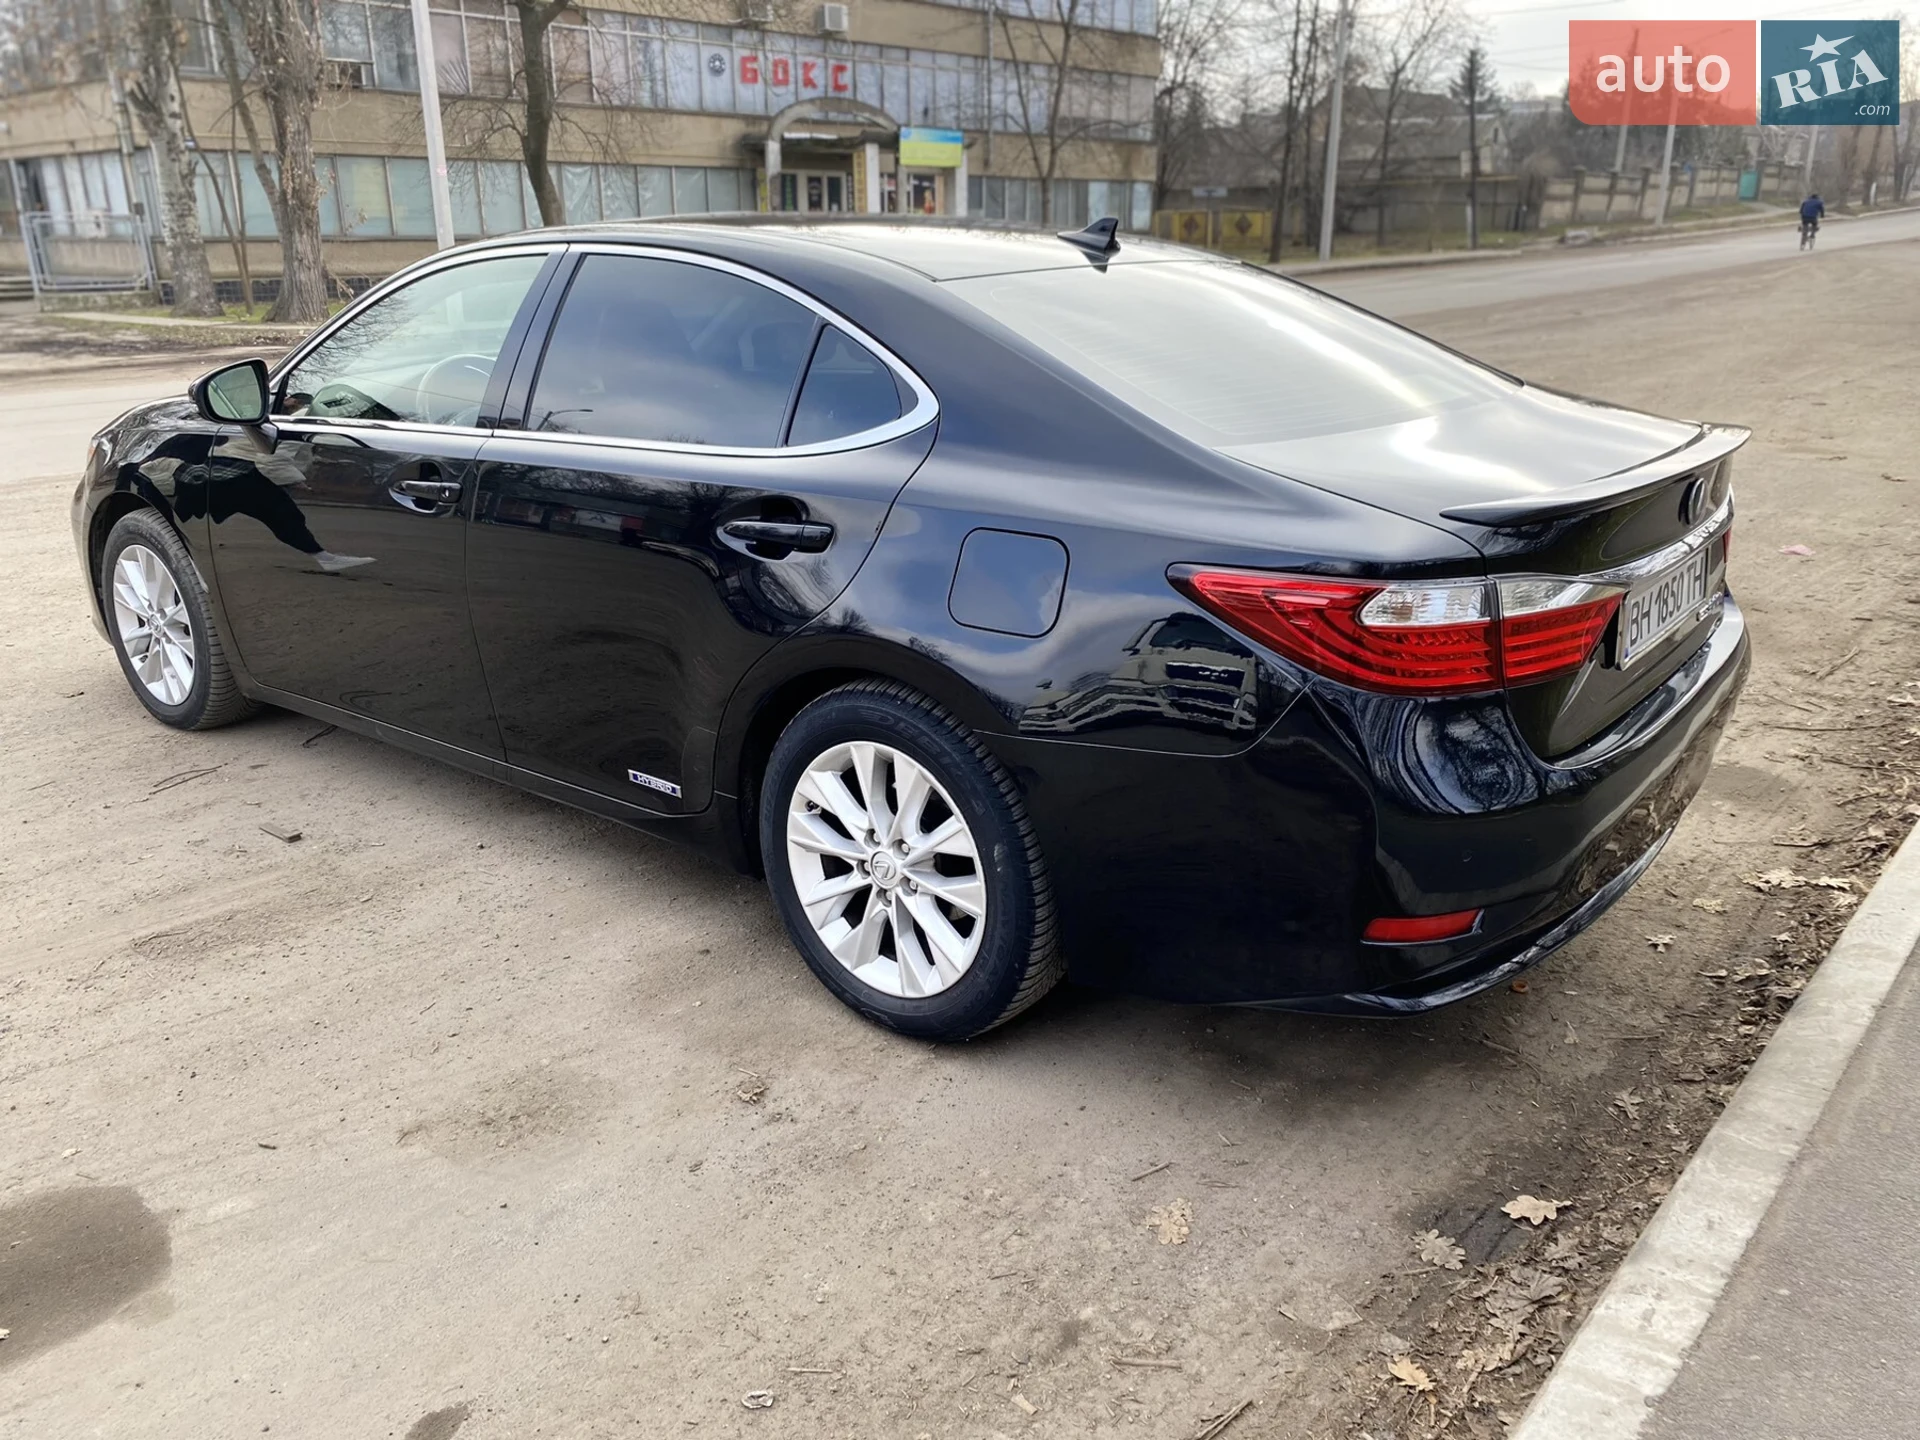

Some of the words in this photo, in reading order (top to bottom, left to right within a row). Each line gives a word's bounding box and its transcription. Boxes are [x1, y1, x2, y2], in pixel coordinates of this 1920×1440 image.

[740, 56, 849, 92] БОКС
[1630, 591, 1653, 648] BH
[1655, 571, 1684, 628] 1850
[1686, 556, 1704, 605] TH
